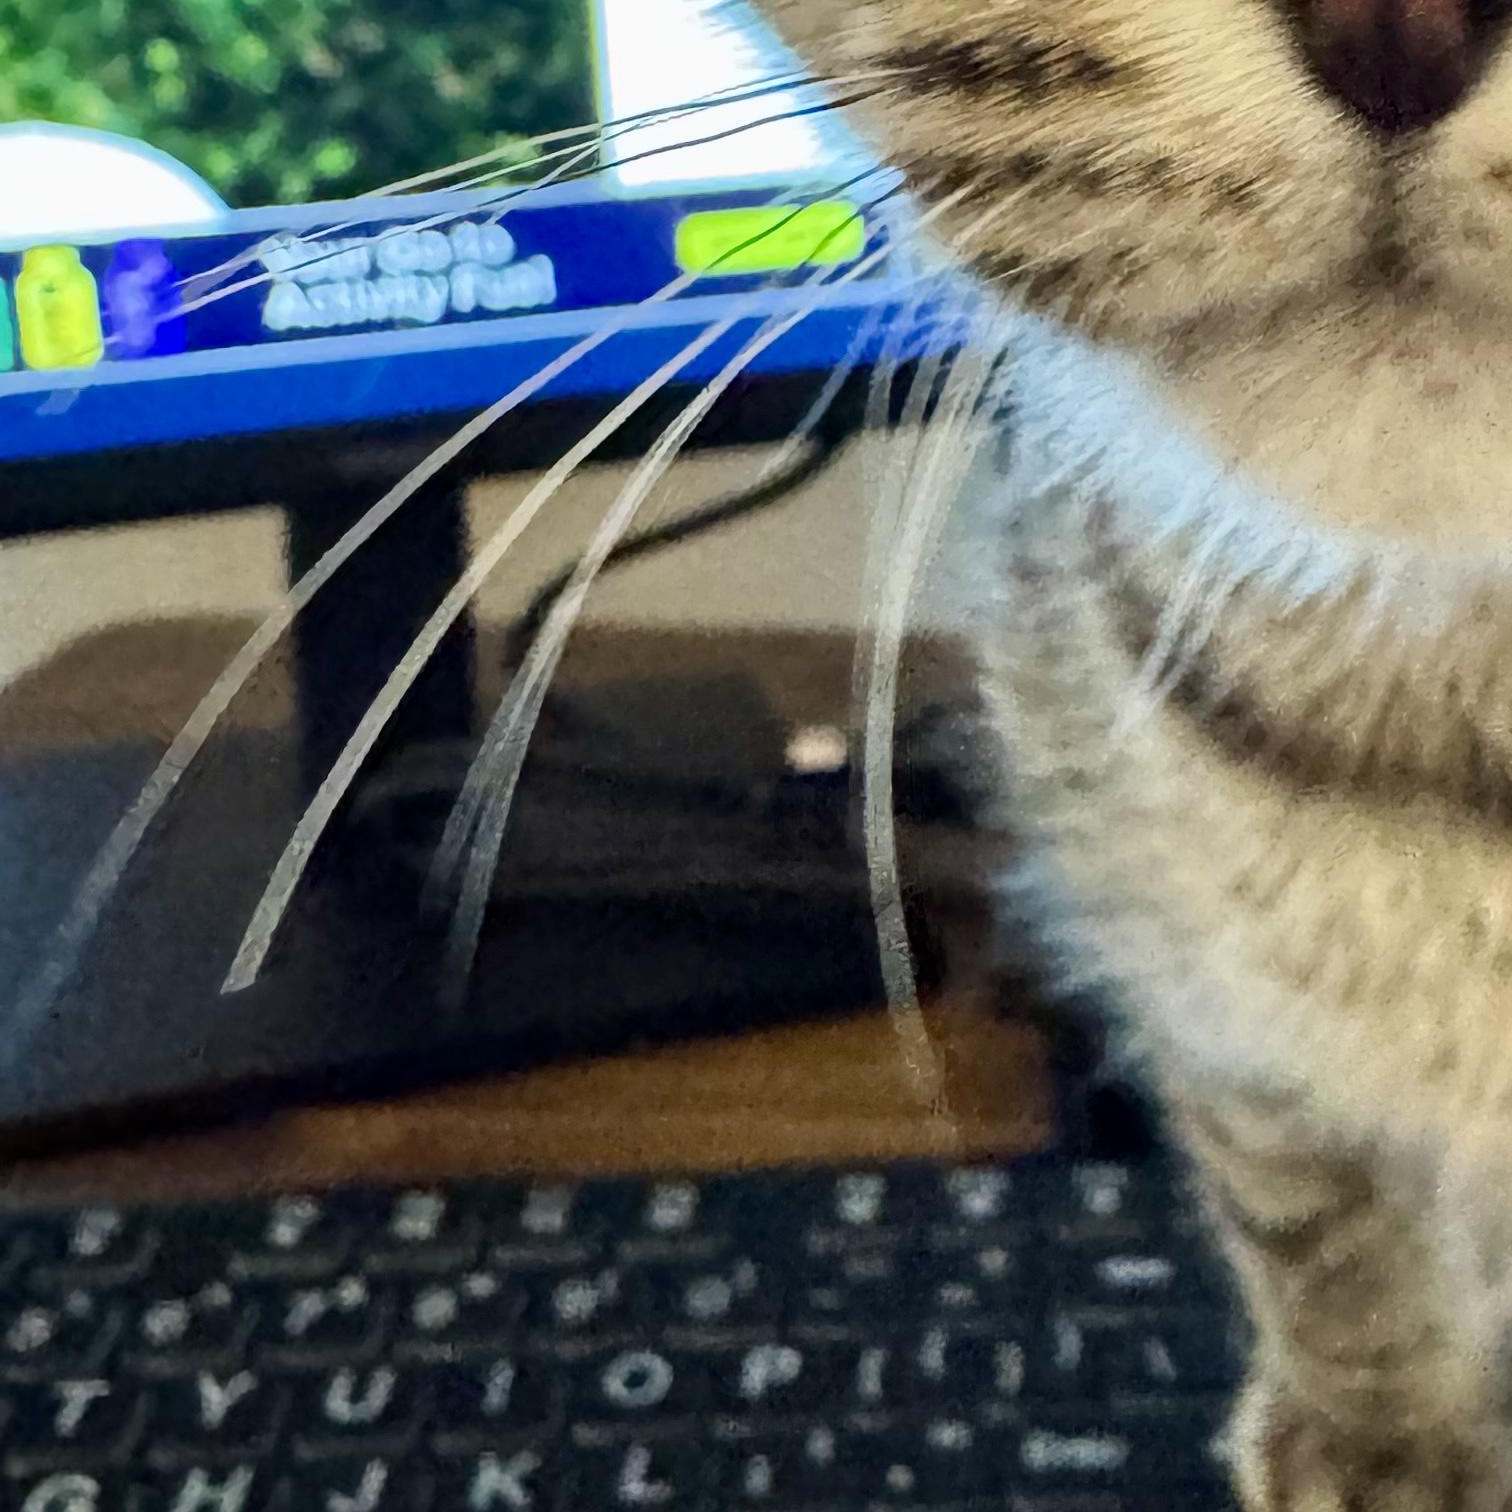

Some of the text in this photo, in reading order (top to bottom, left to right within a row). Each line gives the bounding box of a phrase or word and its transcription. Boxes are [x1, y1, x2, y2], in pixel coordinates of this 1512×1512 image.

[55, 1378, 109, 1434] T
[197, 1369, 257, 1427] Y
[325, 1366, 397, 1423] U
[602, 1350, 673, 1406] O
[739, 1343, 801, 1399] P
[469, 1450, 541, 1510] K
[617, 1445, 671, 1504] L
